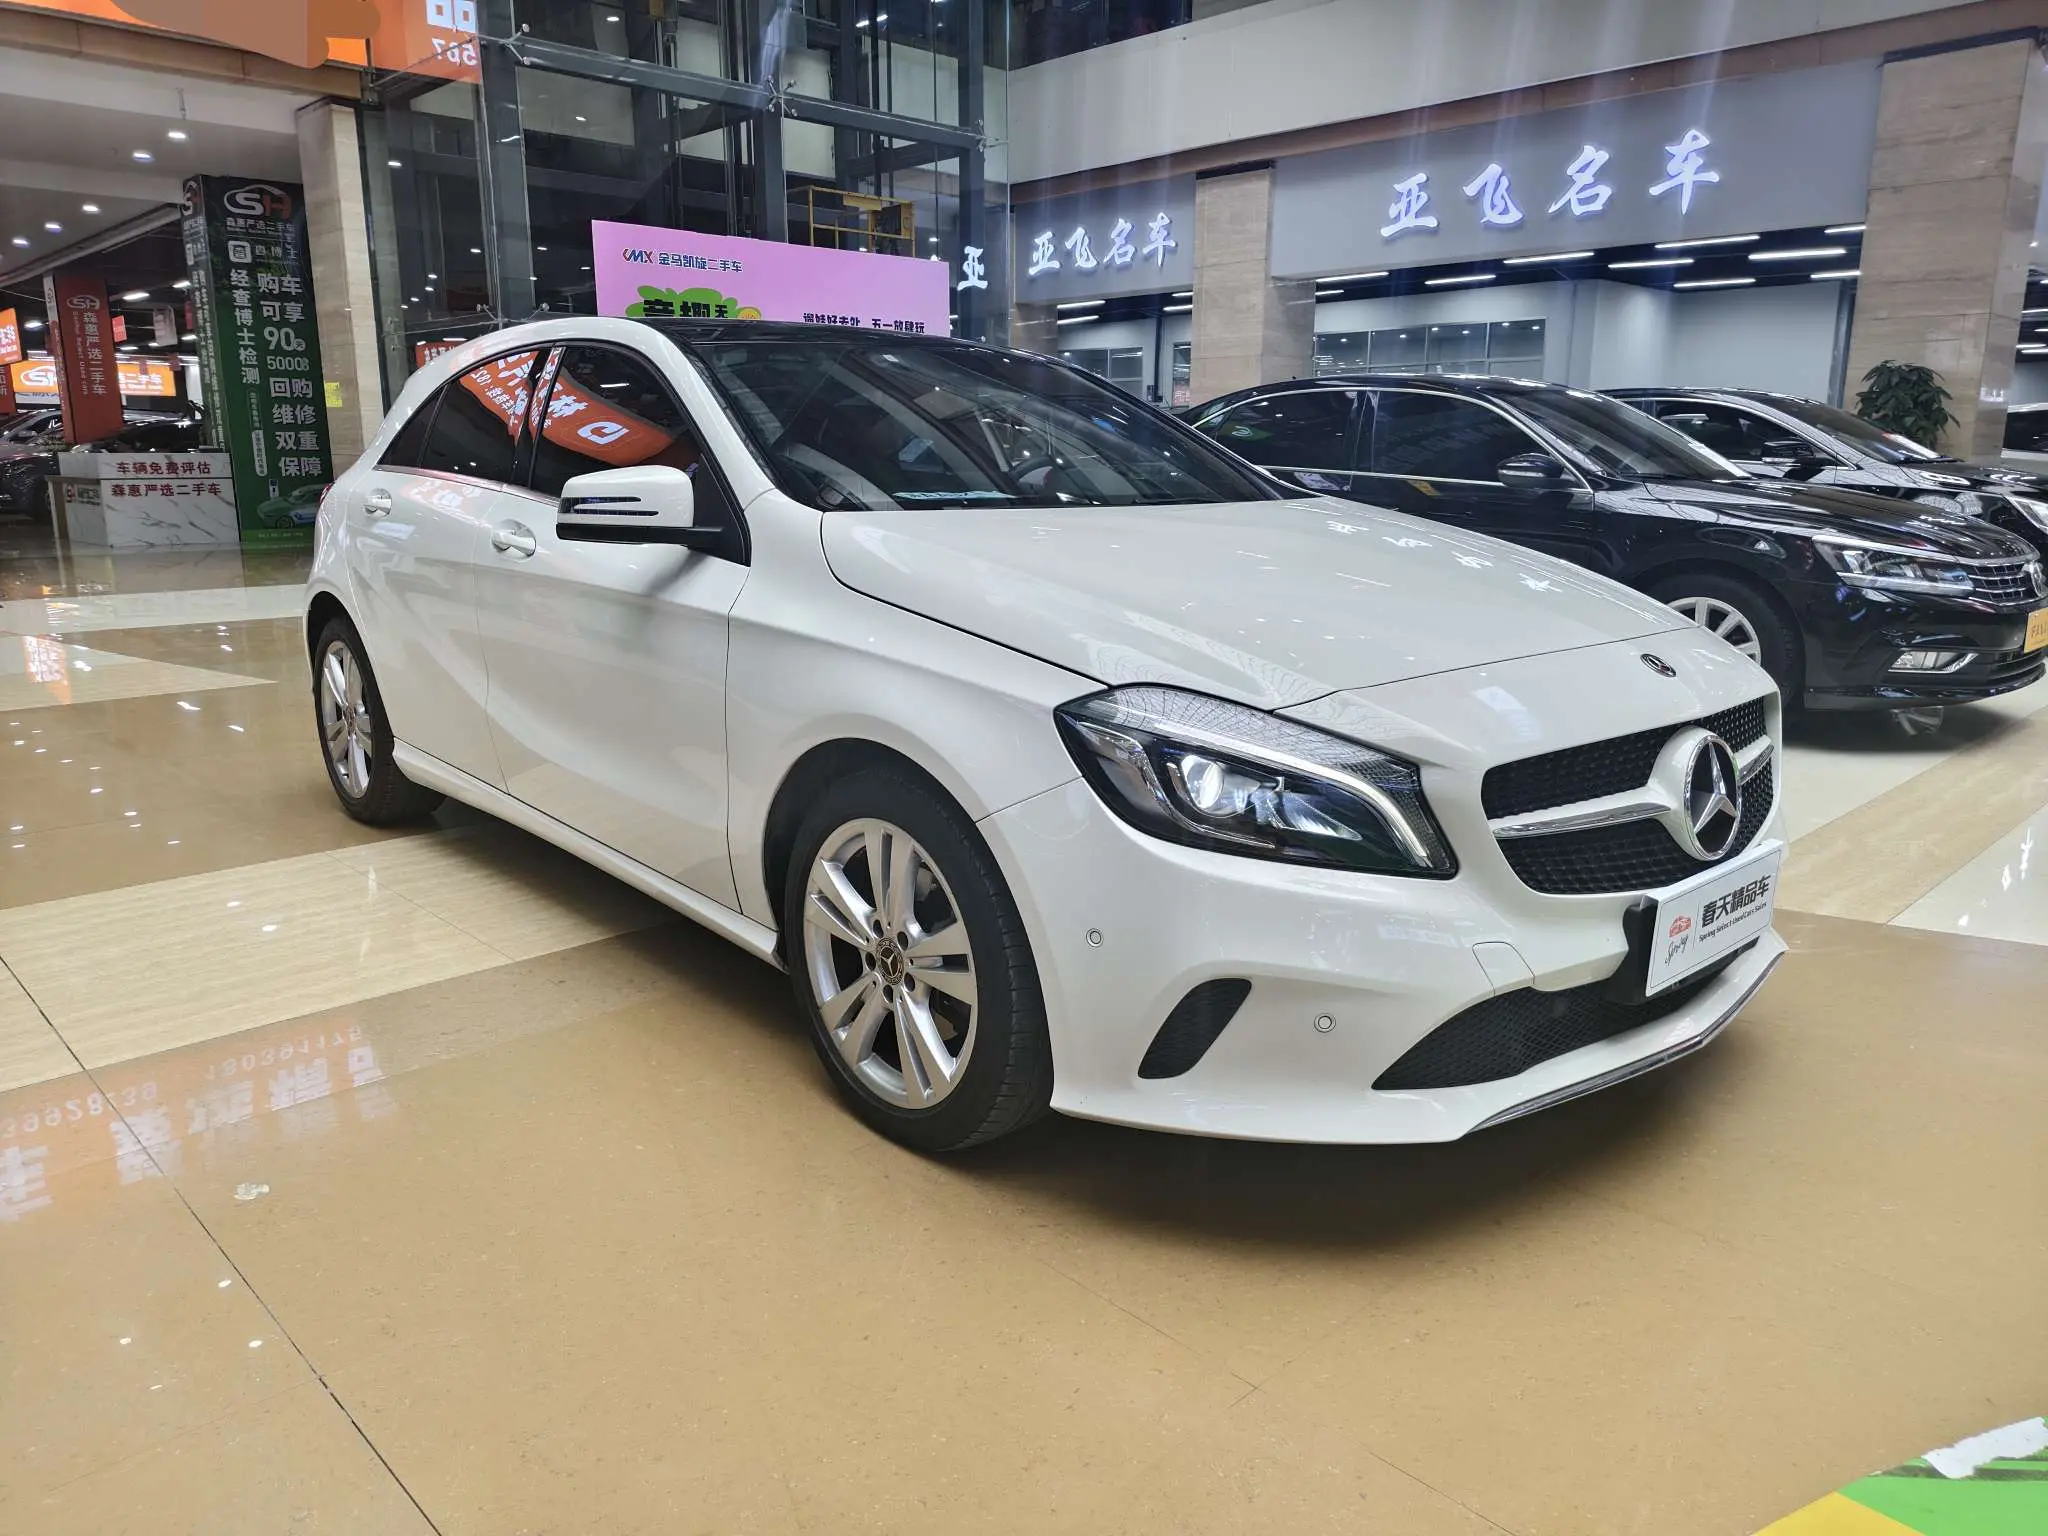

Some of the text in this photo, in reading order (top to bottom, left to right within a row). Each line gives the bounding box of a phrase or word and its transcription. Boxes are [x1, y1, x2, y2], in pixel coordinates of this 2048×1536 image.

[1380, 129, 1720, 237] 亚飞名车
[1028, 212, 1176, 275] 亚飞名车
[659, 253, 743, 272] 金马凯旋二手车
[257, 273, 302, 295] 购车
[260, 301, 305, 323] 可享
[230, 269, 260, 385] 经查博士检测
[269, 377, 312, 398] 回购
[272, 404, 316, 425] 维修
[275, 431, 320, 451] 双重
[116, 461, 211, 475] 车辆免费评估
[279, 456, 322, 477] 保障
[111, 483, 222, 497] 森惠严选二手车
[1702, 874, 1771, 928] 春天精品车
